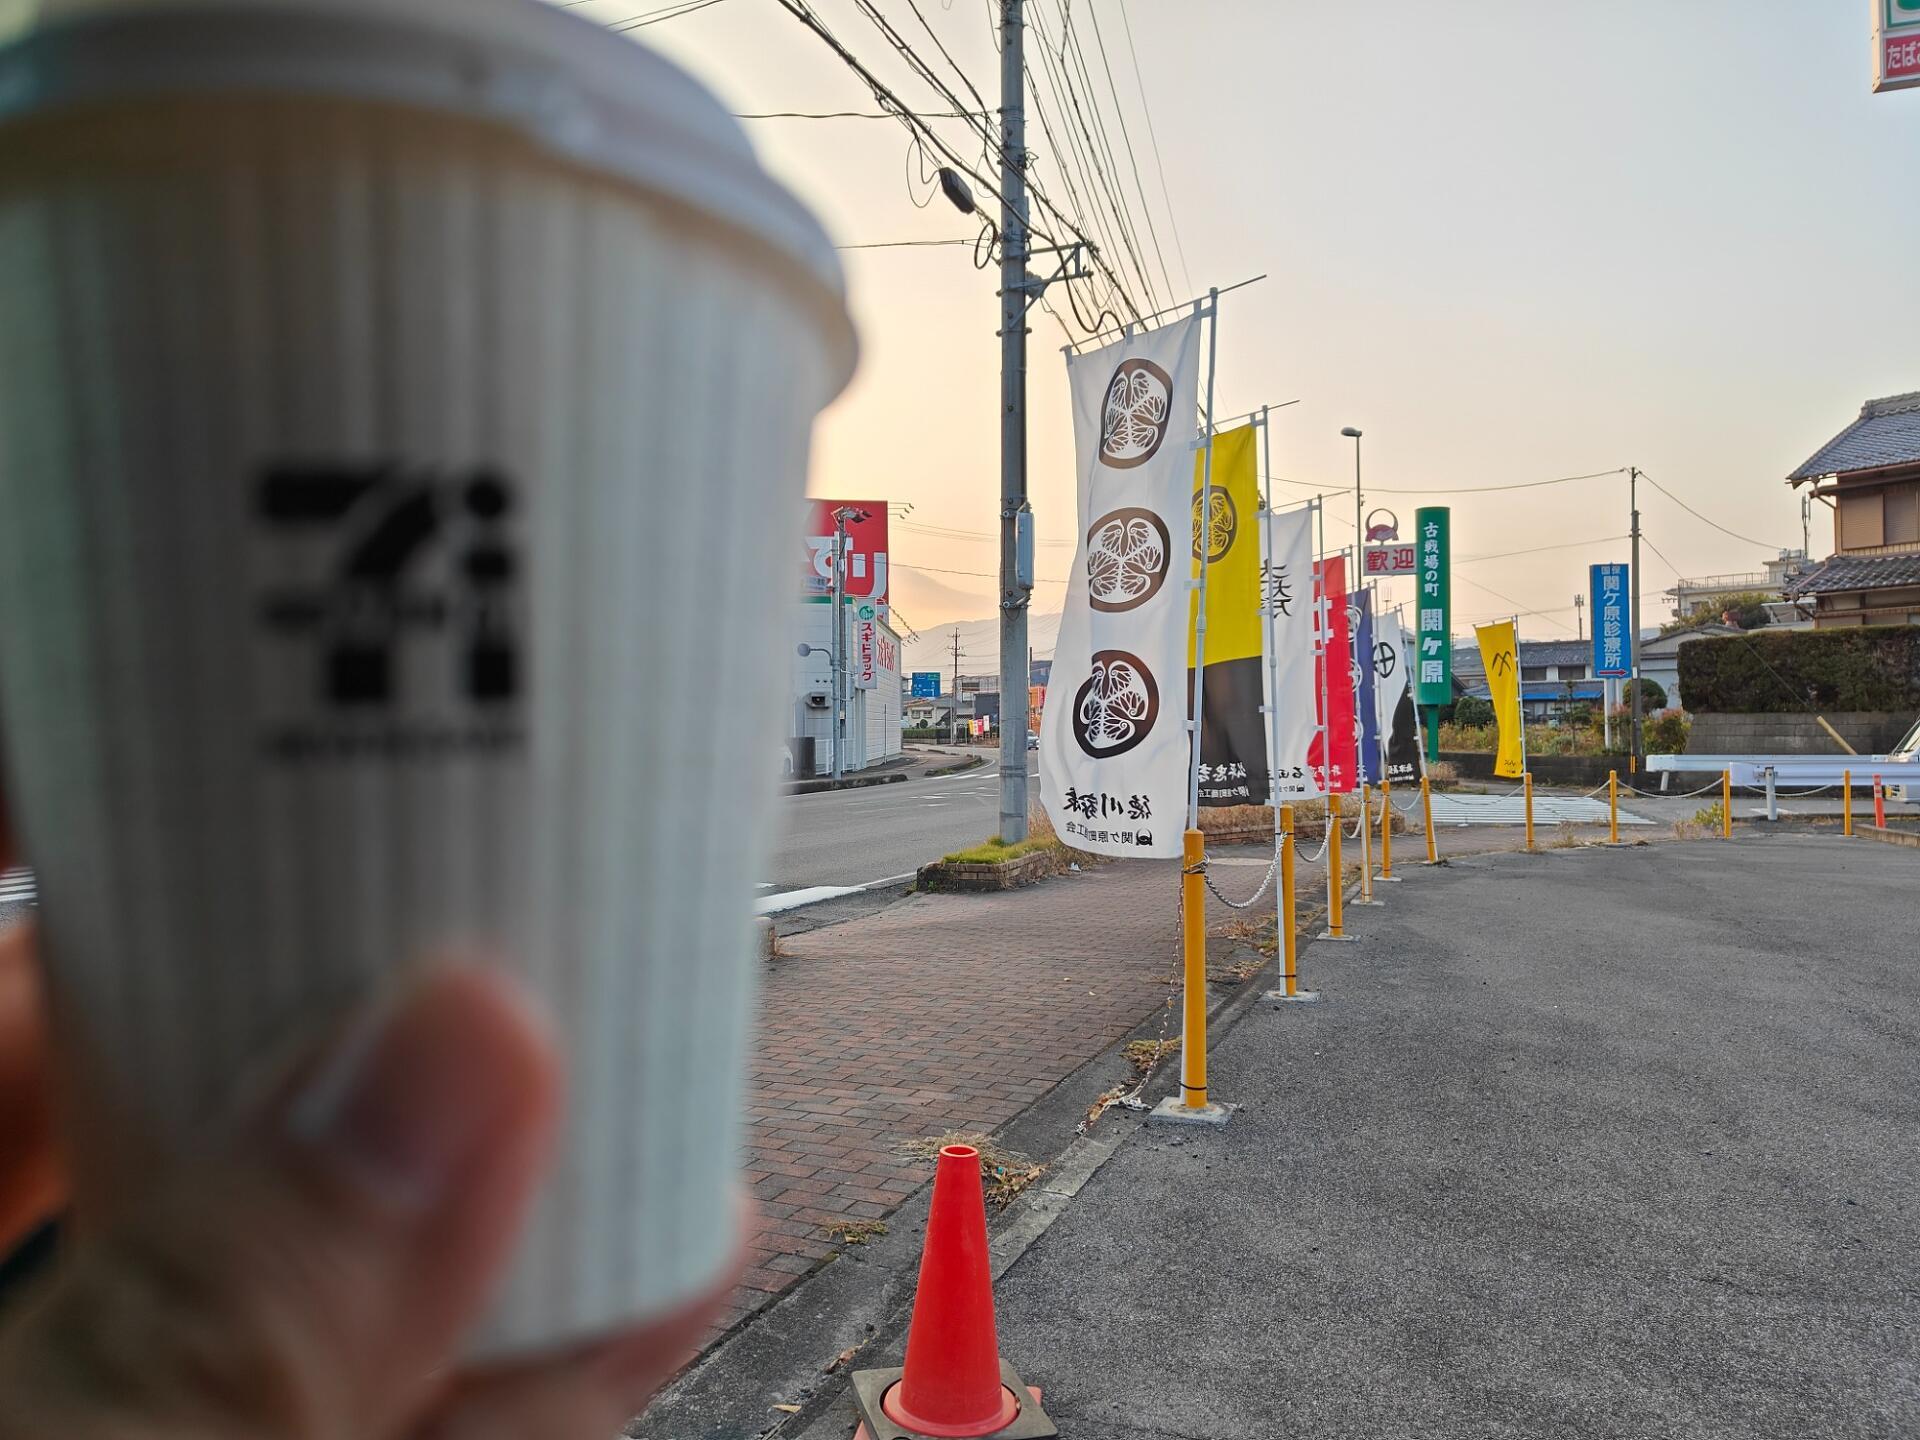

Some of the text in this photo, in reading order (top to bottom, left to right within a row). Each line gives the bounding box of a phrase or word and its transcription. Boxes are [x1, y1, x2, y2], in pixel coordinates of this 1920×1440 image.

[1366, 547, 1415, 571] 歓迎
[1423, 522, 1440, 598] 古戦場の町
[861, 622, 876, 682] スギドラッグ
[1420, 608, 1444, 684] 関ケ原
[1602, 575, 1622, 669] 関ケ原診療所
